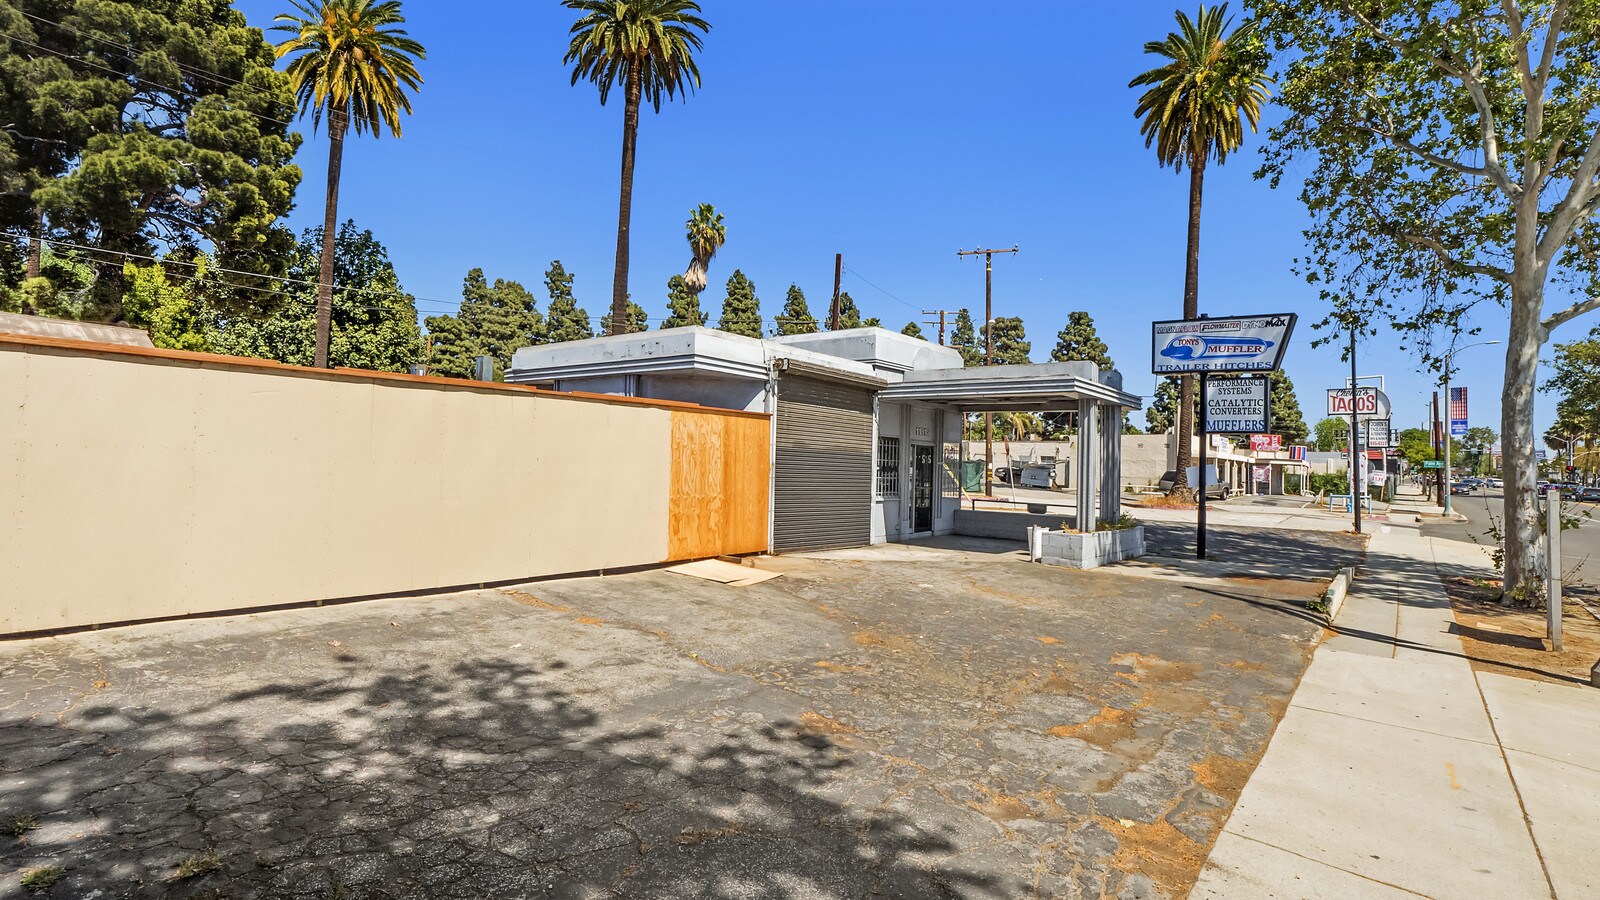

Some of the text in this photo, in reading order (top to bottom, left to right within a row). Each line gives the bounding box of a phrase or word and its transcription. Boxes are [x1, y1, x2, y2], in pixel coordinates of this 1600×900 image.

[1201, 322, 1240, 332] FLOWMASTER
[1207, 345, 1262, 353] MUFFLER
[1157, 361, 1272, 371] TRAILER HITCHES
[1208, 379, 1264, 387] PERFORMANCE
[1217, 387, 1252, 395] SYSTEMS
[1208, 399, 1264, 407] CATALYTIC
[1330, 394, 1375, 412] TACOS
[1209, 407, 1262, 416] CONVERTERS
[1206, 419, 1265, 431] MUFFLERS
